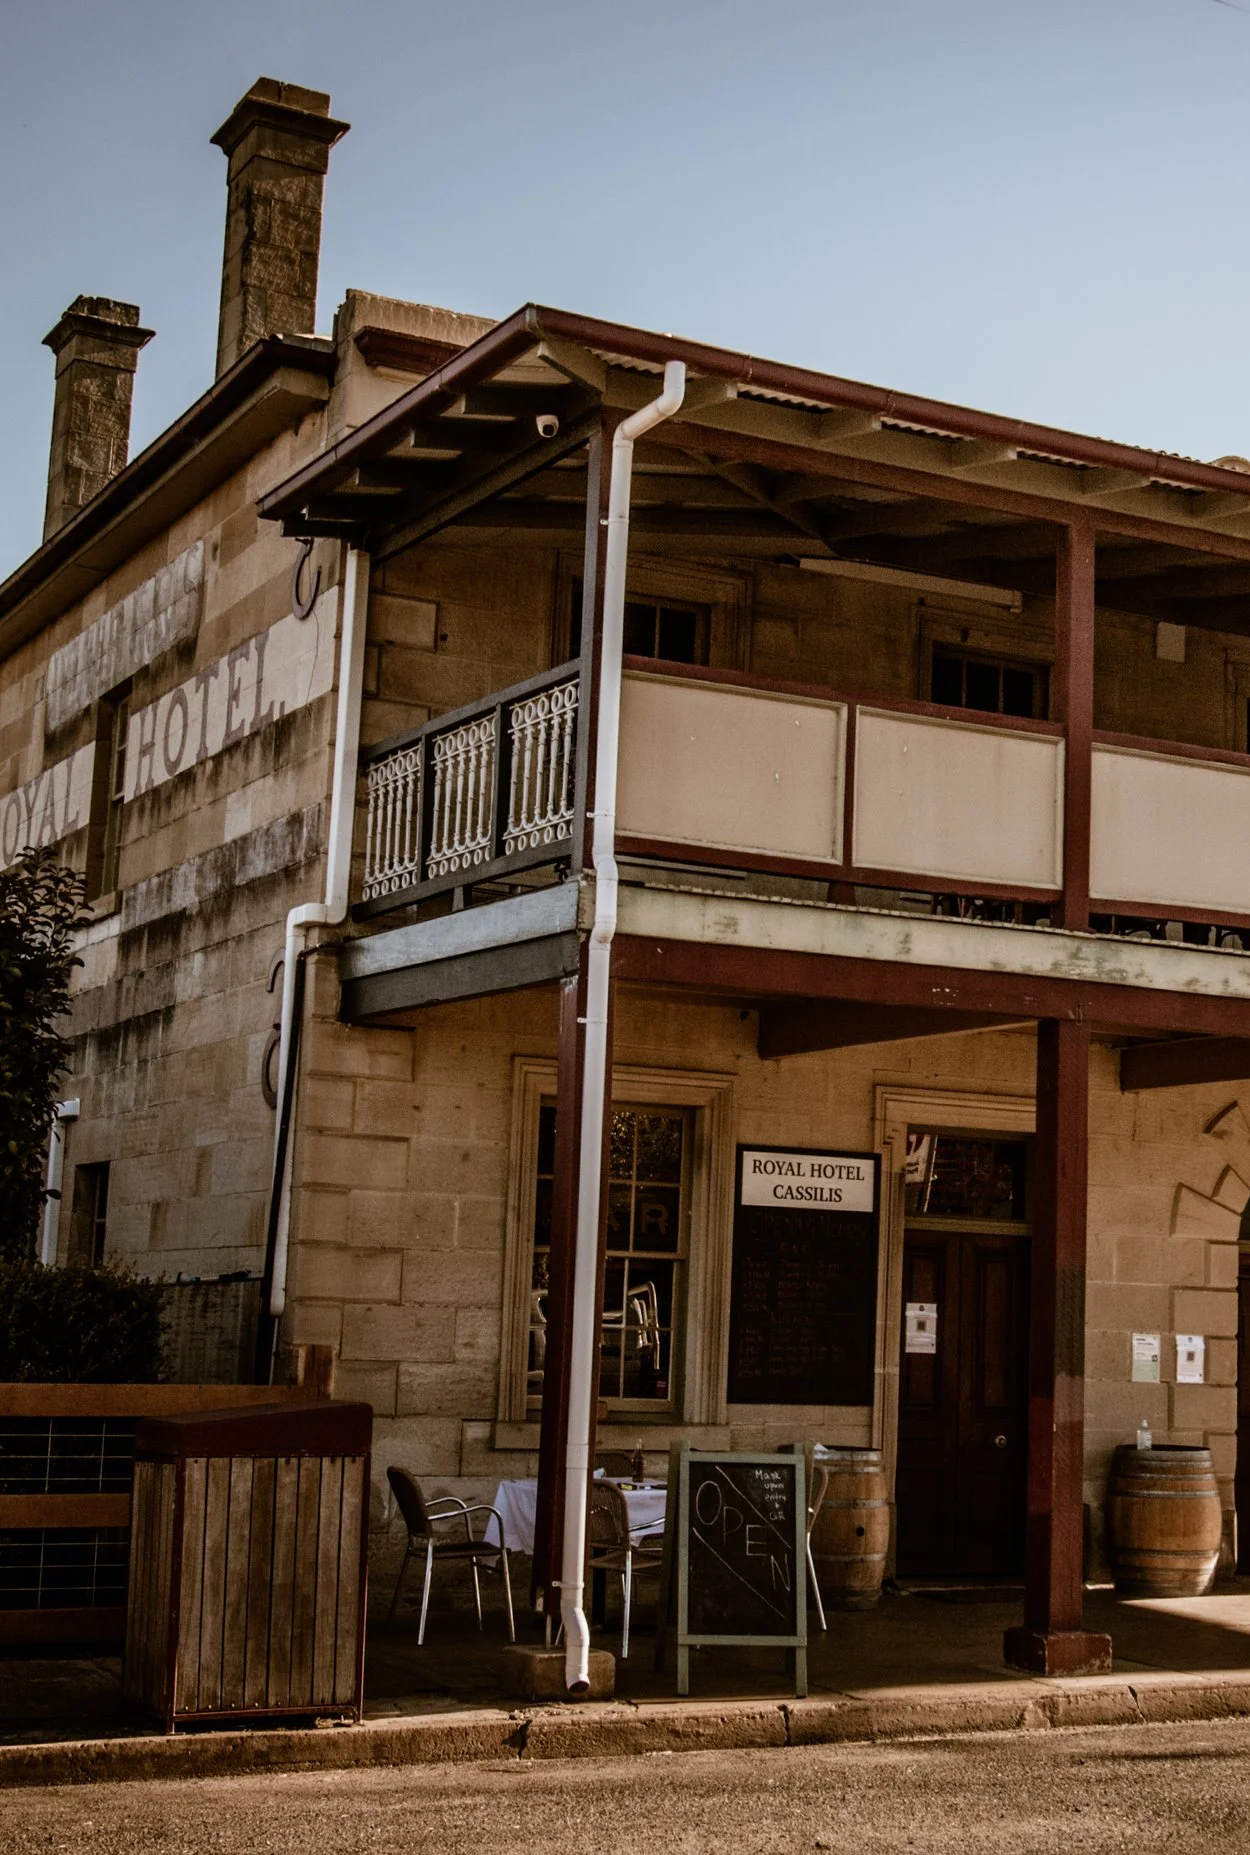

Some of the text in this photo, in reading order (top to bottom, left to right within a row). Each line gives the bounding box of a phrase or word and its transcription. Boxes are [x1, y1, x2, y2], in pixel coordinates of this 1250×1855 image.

[751, 1159, 865, 1181] ROYAL HOTEL
[773, 1184, 843, 1203] CASSILIS
[755, 1469, 781, 1480] Mask
[695, 1480, 791, 1592] OPEN
